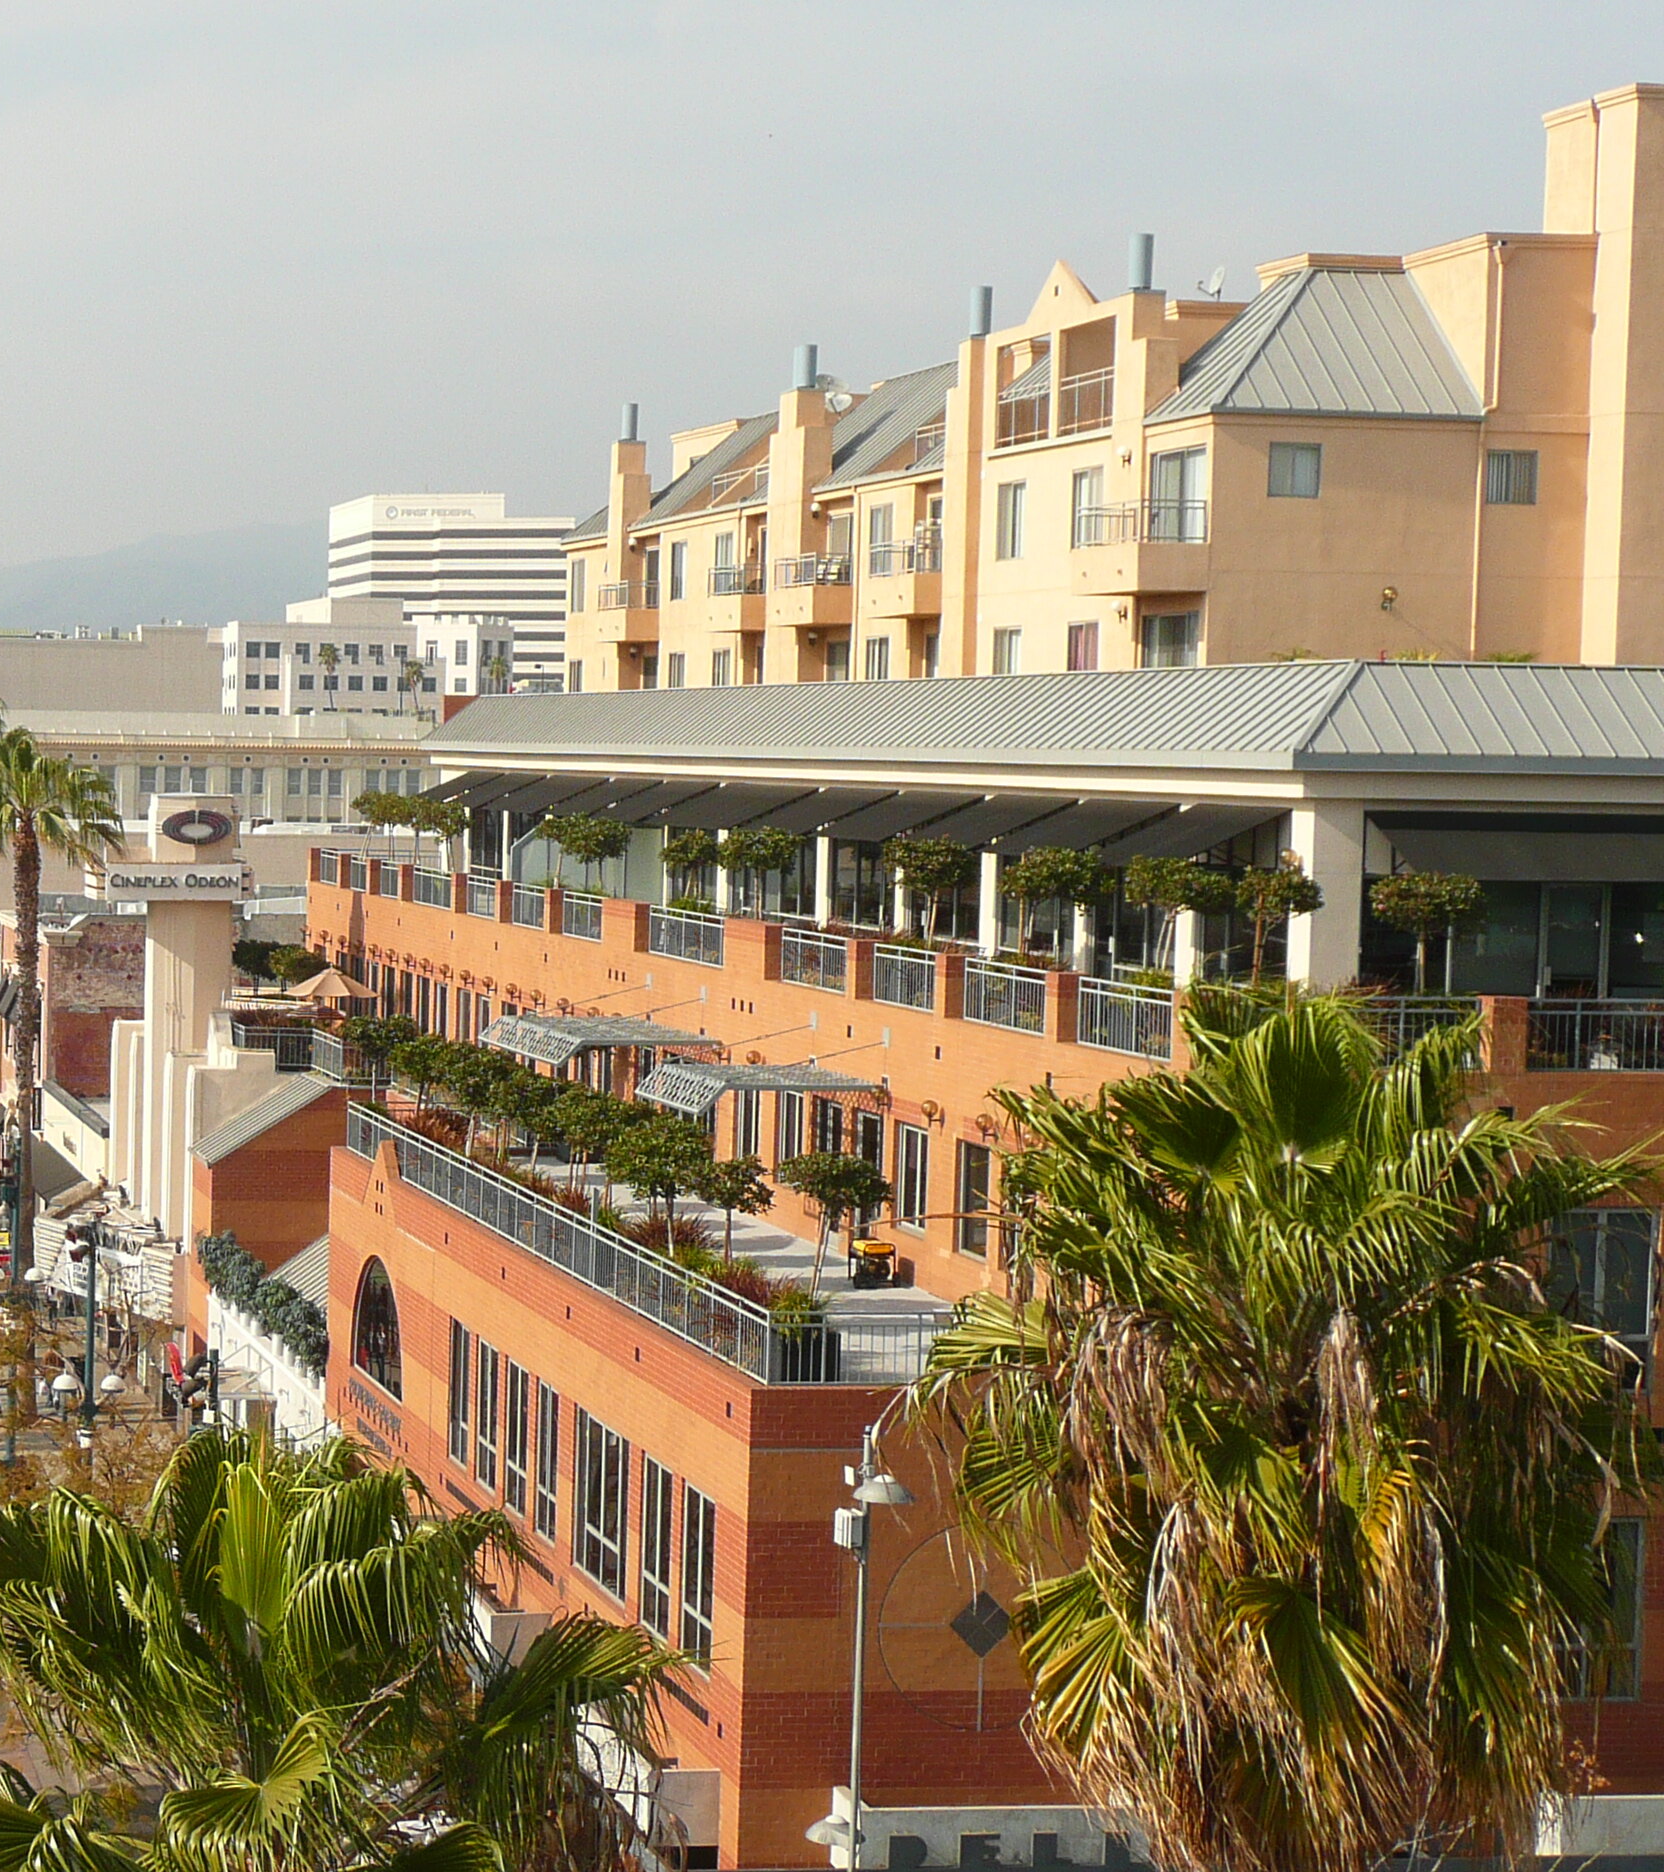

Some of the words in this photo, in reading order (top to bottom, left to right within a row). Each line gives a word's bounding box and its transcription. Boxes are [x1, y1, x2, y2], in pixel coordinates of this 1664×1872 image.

[400, 508, 429, 517] FIRST
[431, 508, 475, 518] FEDERAL
[110, 873, 178, 889] CINEPLEX
[184, 873, 239, 889] ODEON
